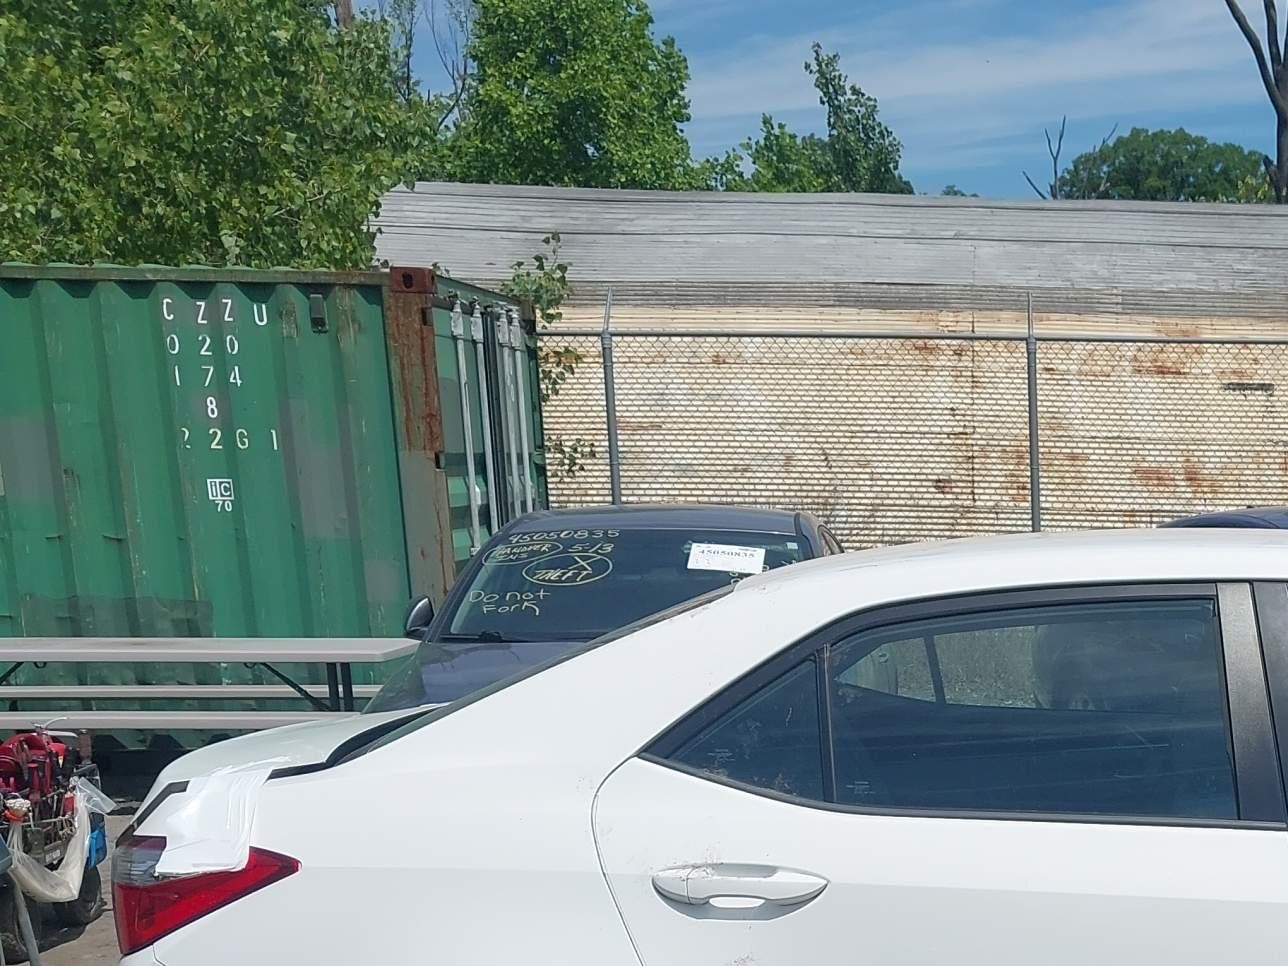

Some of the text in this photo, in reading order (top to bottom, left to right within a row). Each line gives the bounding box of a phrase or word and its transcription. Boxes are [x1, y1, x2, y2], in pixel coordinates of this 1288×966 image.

[162, 298, 267, 325] CZZU
[166, 334, 239, 355] 020
[174, 365, 242, 387] 174
[206, 396, 218, 418] 8
[214, 500, 232, 513] 70
[508, 529, 620, 544] 45050835
[531, 568, 593, 582] THEFT
[470, 587, 552, 603] Do not
